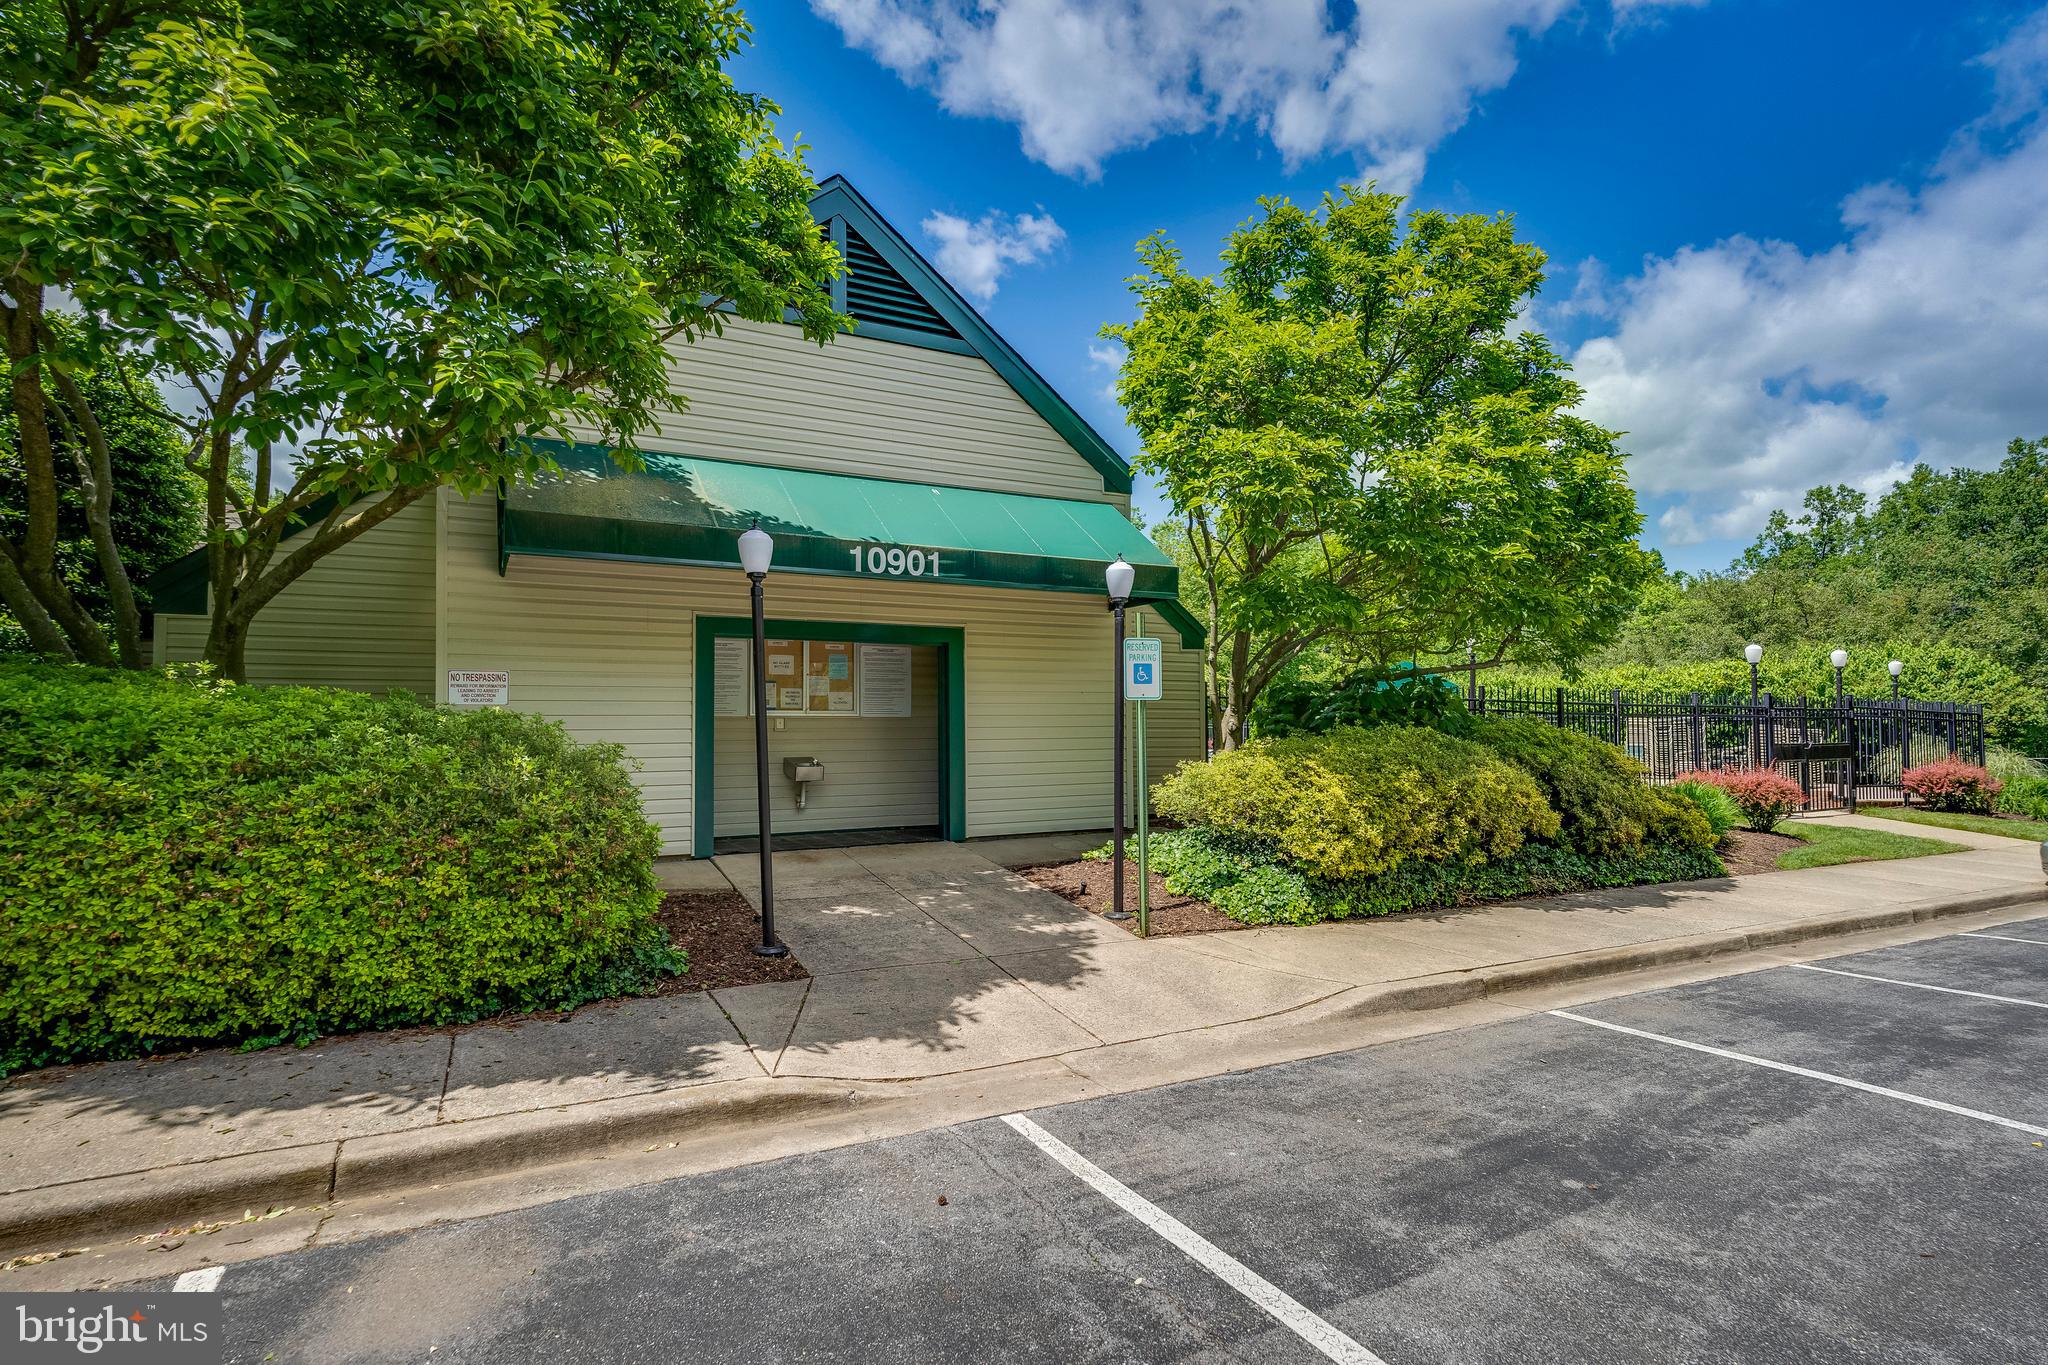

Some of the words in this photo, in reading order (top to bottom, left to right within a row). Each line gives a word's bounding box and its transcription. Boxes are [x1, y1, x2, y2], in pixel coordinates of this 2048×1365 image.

[850, 546, 939, 577] 10901
[1127, 643, 1158, 651] RESERVED
[450, 673, 460, 681] NO
[462, 673, 506, 682] TRESPASSING
